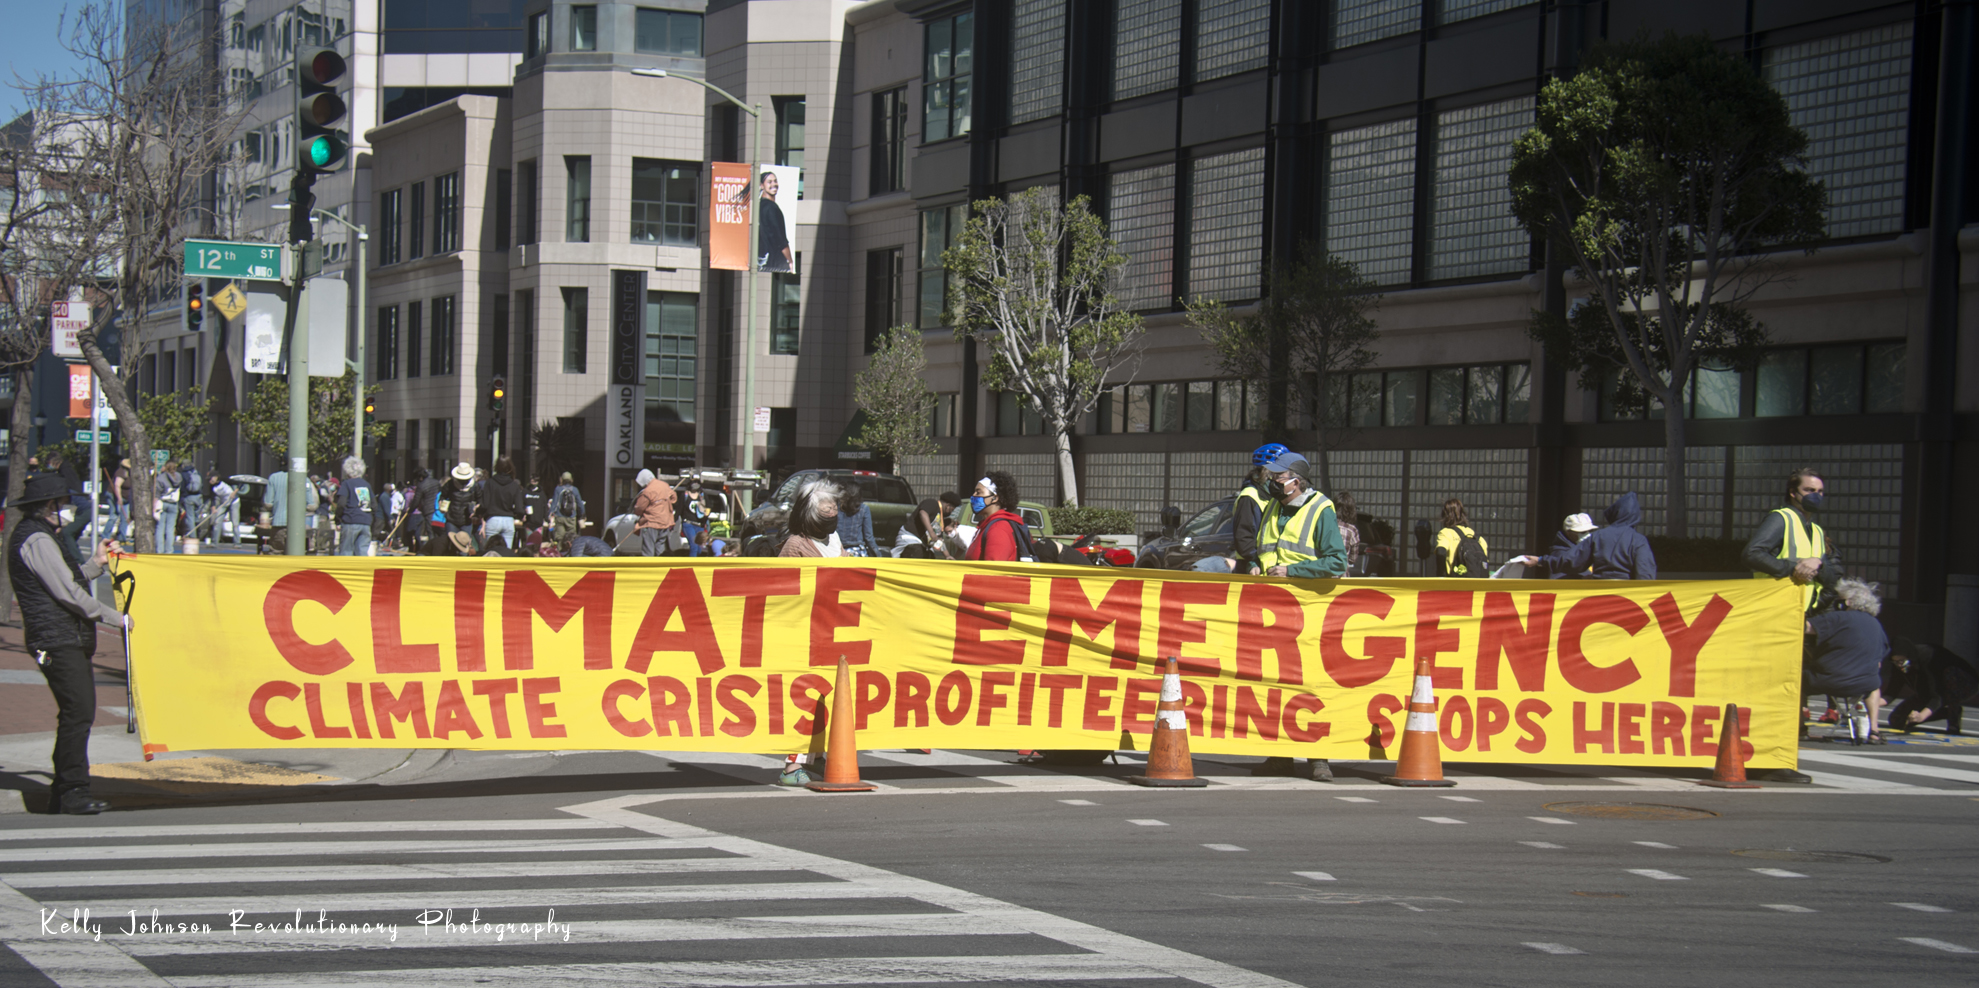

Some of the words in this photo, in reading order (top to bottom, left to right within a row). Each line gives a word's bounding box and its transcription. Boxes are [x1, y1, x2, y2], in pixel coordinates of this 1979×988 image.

[198, 248, 236, 270] 12th
[260, 249, 275, 259] ST
[54, 303, 68, 316] NO
[56, 319, 88, 330] PARKING
[618, 274, 636, 337] CENTER
[618, 343, 634, 381] CITY
[616, 387, 633, 465] OAKLAND
[263, 567, 877, 676] CLIMATE
[952, 573, 1732, 698] EMERGENCY
[248, 676, 567, 740] CLIMATE
[601, 673, 830, 739] CRISIS
[855, 670, 1331, 743] PROFITEERING
[1363, 693, 1553, 756] SOPS
